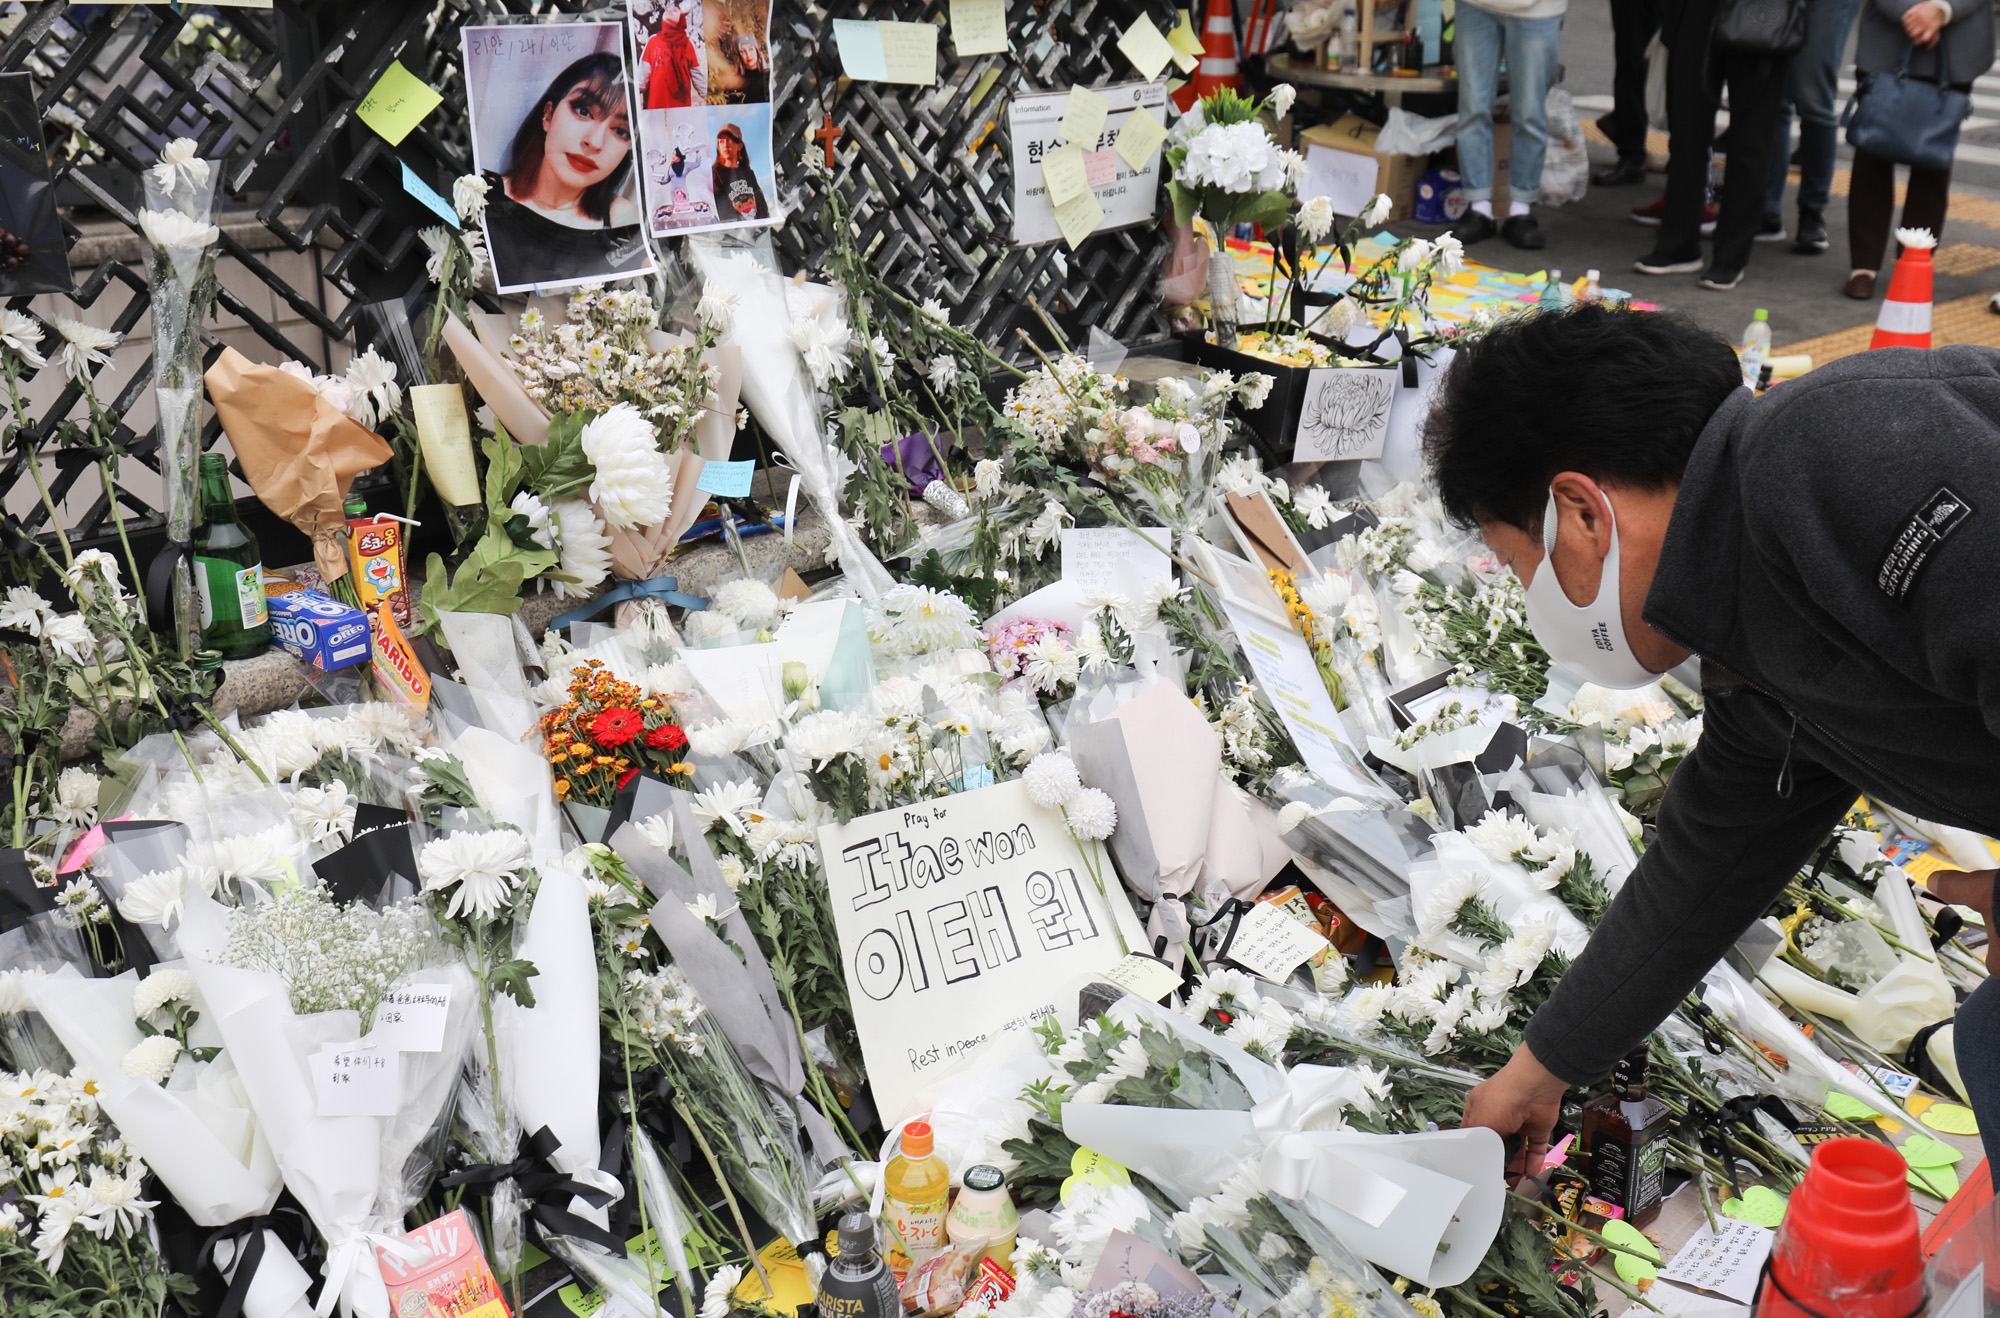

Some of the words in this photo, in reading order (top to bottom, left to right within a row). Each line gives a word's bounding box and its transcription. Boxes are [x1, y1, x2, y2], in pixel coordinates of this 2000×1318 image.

[1015, 104, 1051, 114] Information
[1026, 186, 1046, 197] 바람에
[1102, 186, 1128, 198] 바랍니다.
[1894, 521, 1917, 553] STOP
[1886, 529, 1928, 597] EXPLORING
[329, 624, 365, 646] OREO
[1591, 628, 1605, 650] EDIYA
[1598, 621, 1614, 652] COFFEE
[377, 620, 423, 695] HARIBO
[904, 811, 930, 829] Pray
[933, 808, 948, 820] for
[855, 868, 1099, 1001] 이태원
[1003, 1015, 1026, 1032] 편히
[1029, 1003, 1058, 1022] 쉬세요
[908, 1044, 940, 1073] Rest
[945, 1041, 957, 1057] in
[957, 1032, 987, 1059] peace
[1614, 1071, 1629, 1082] RFID
[380, 1225, 459, 1278] Pcky
[425, 1277, 441, 1289] 포키
[440, 1269, 455, 1281] 딸기
